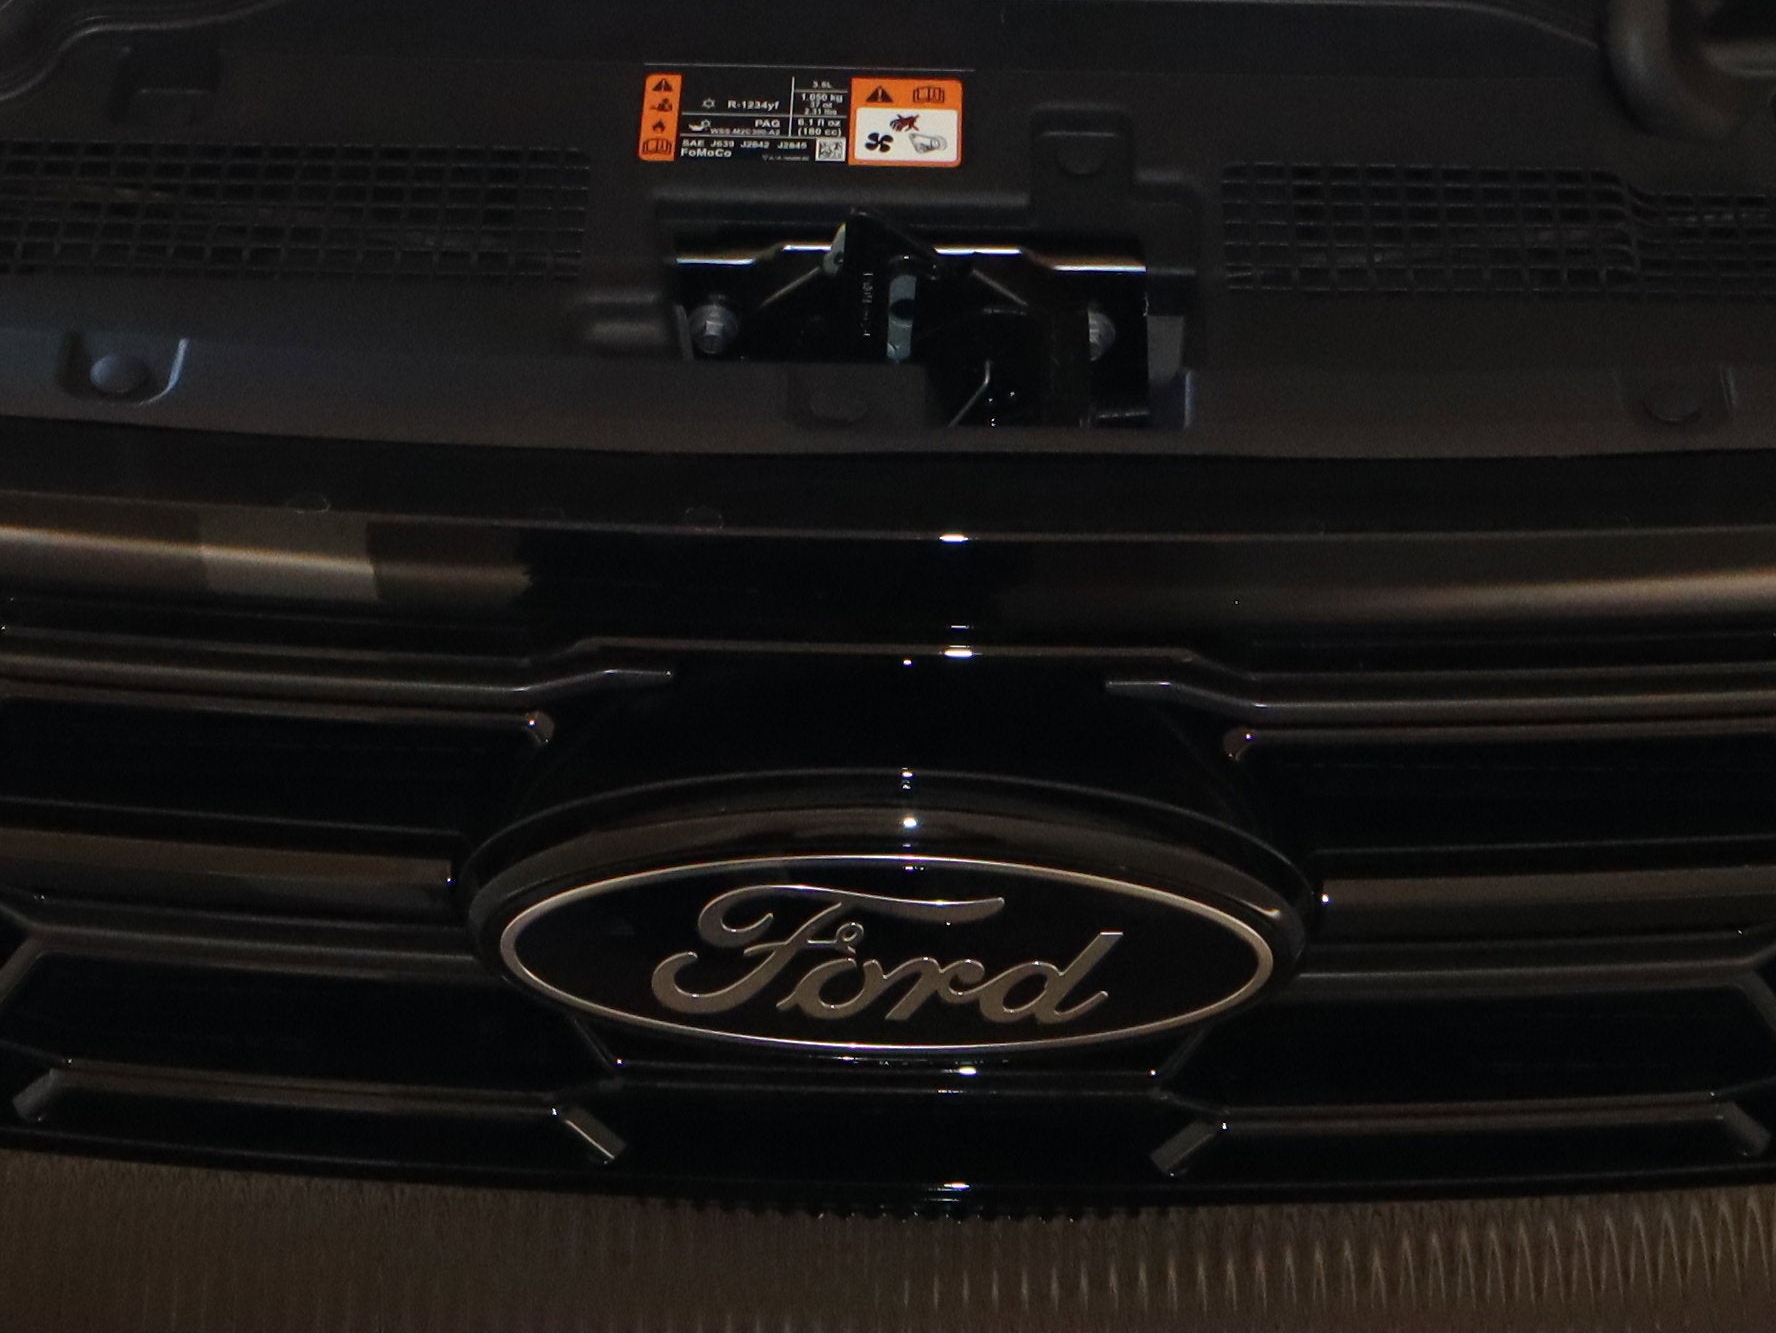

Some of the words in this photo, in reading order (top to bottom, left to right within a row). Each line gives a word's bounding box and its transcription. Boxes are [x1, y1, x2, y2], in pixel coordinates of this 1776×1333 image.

[727, 99, 780, 112] R-1234yf
[754, 119, 781, 128] PAG
[680, 147, 732, 158] FoMoCo
[651, 884, 1124, 1025] Ford
